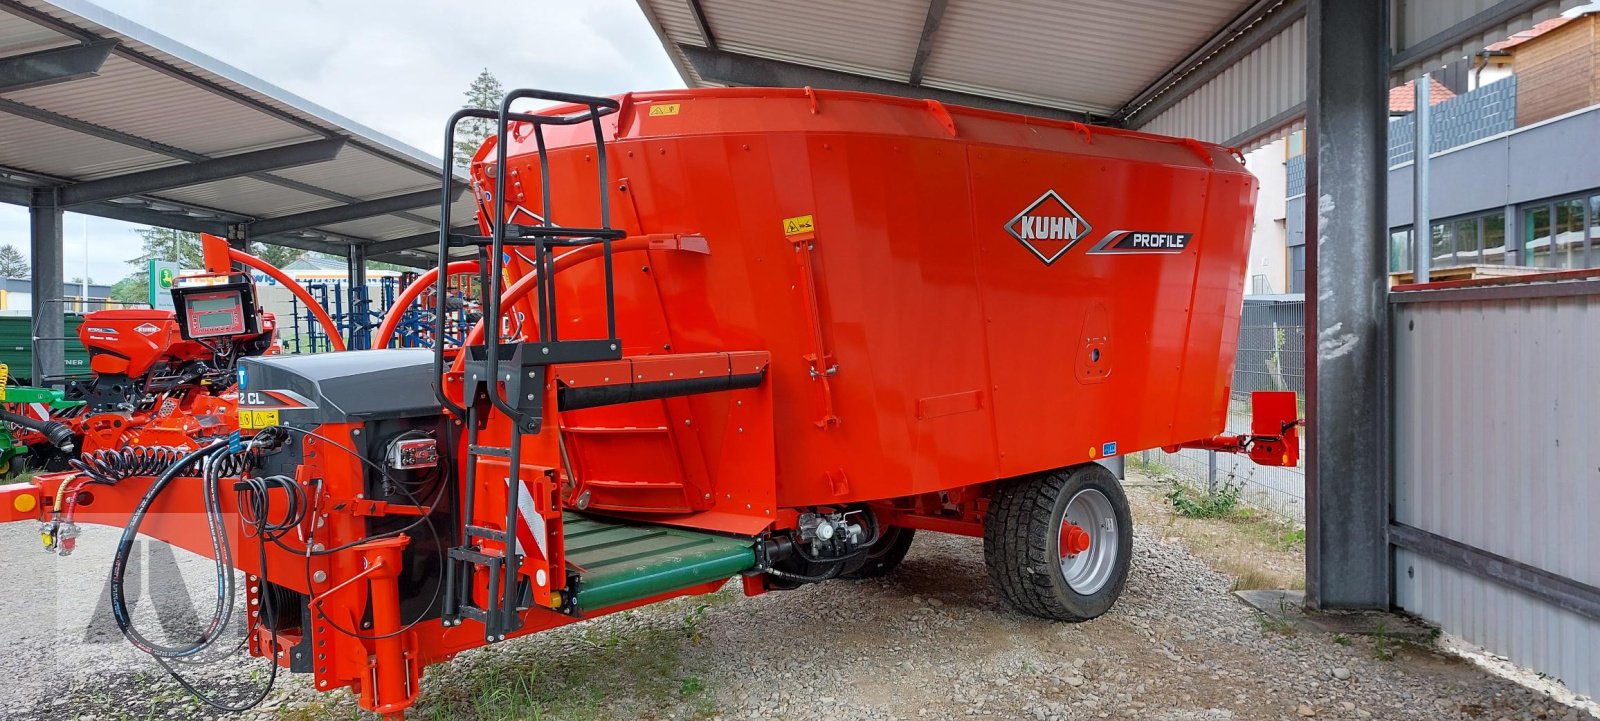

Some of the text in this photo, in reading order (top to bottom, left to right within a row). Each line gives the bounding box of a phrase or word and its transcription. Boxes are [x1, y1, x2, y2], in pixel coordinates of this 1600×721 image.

[1021, 215, 1078, 240] KUHN
[1133, 233, 1184, 248] PROFILE
[247, 392, 265, 405] CL
